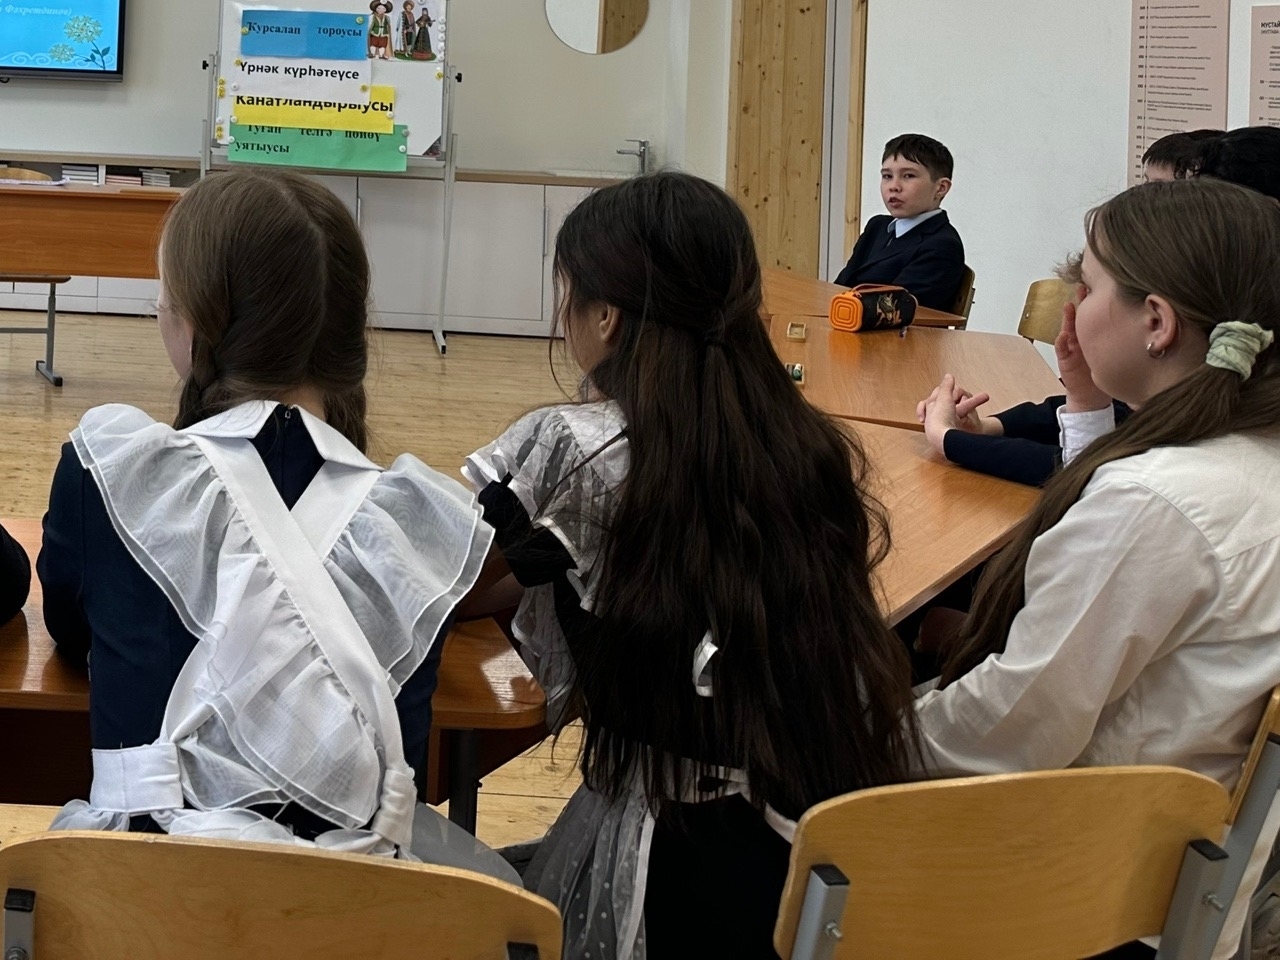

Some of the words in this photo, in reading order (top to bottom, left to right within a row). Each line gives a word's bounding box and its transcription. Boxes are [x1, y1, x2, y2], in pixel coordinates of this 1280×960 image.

[316, 26, 362, 38] тороусы
[240, 61, 279, 76] Үрнәк
[284, 65, 360, 82] күрһәтеүсе
[235, 141, 290, 154] уятыусы
